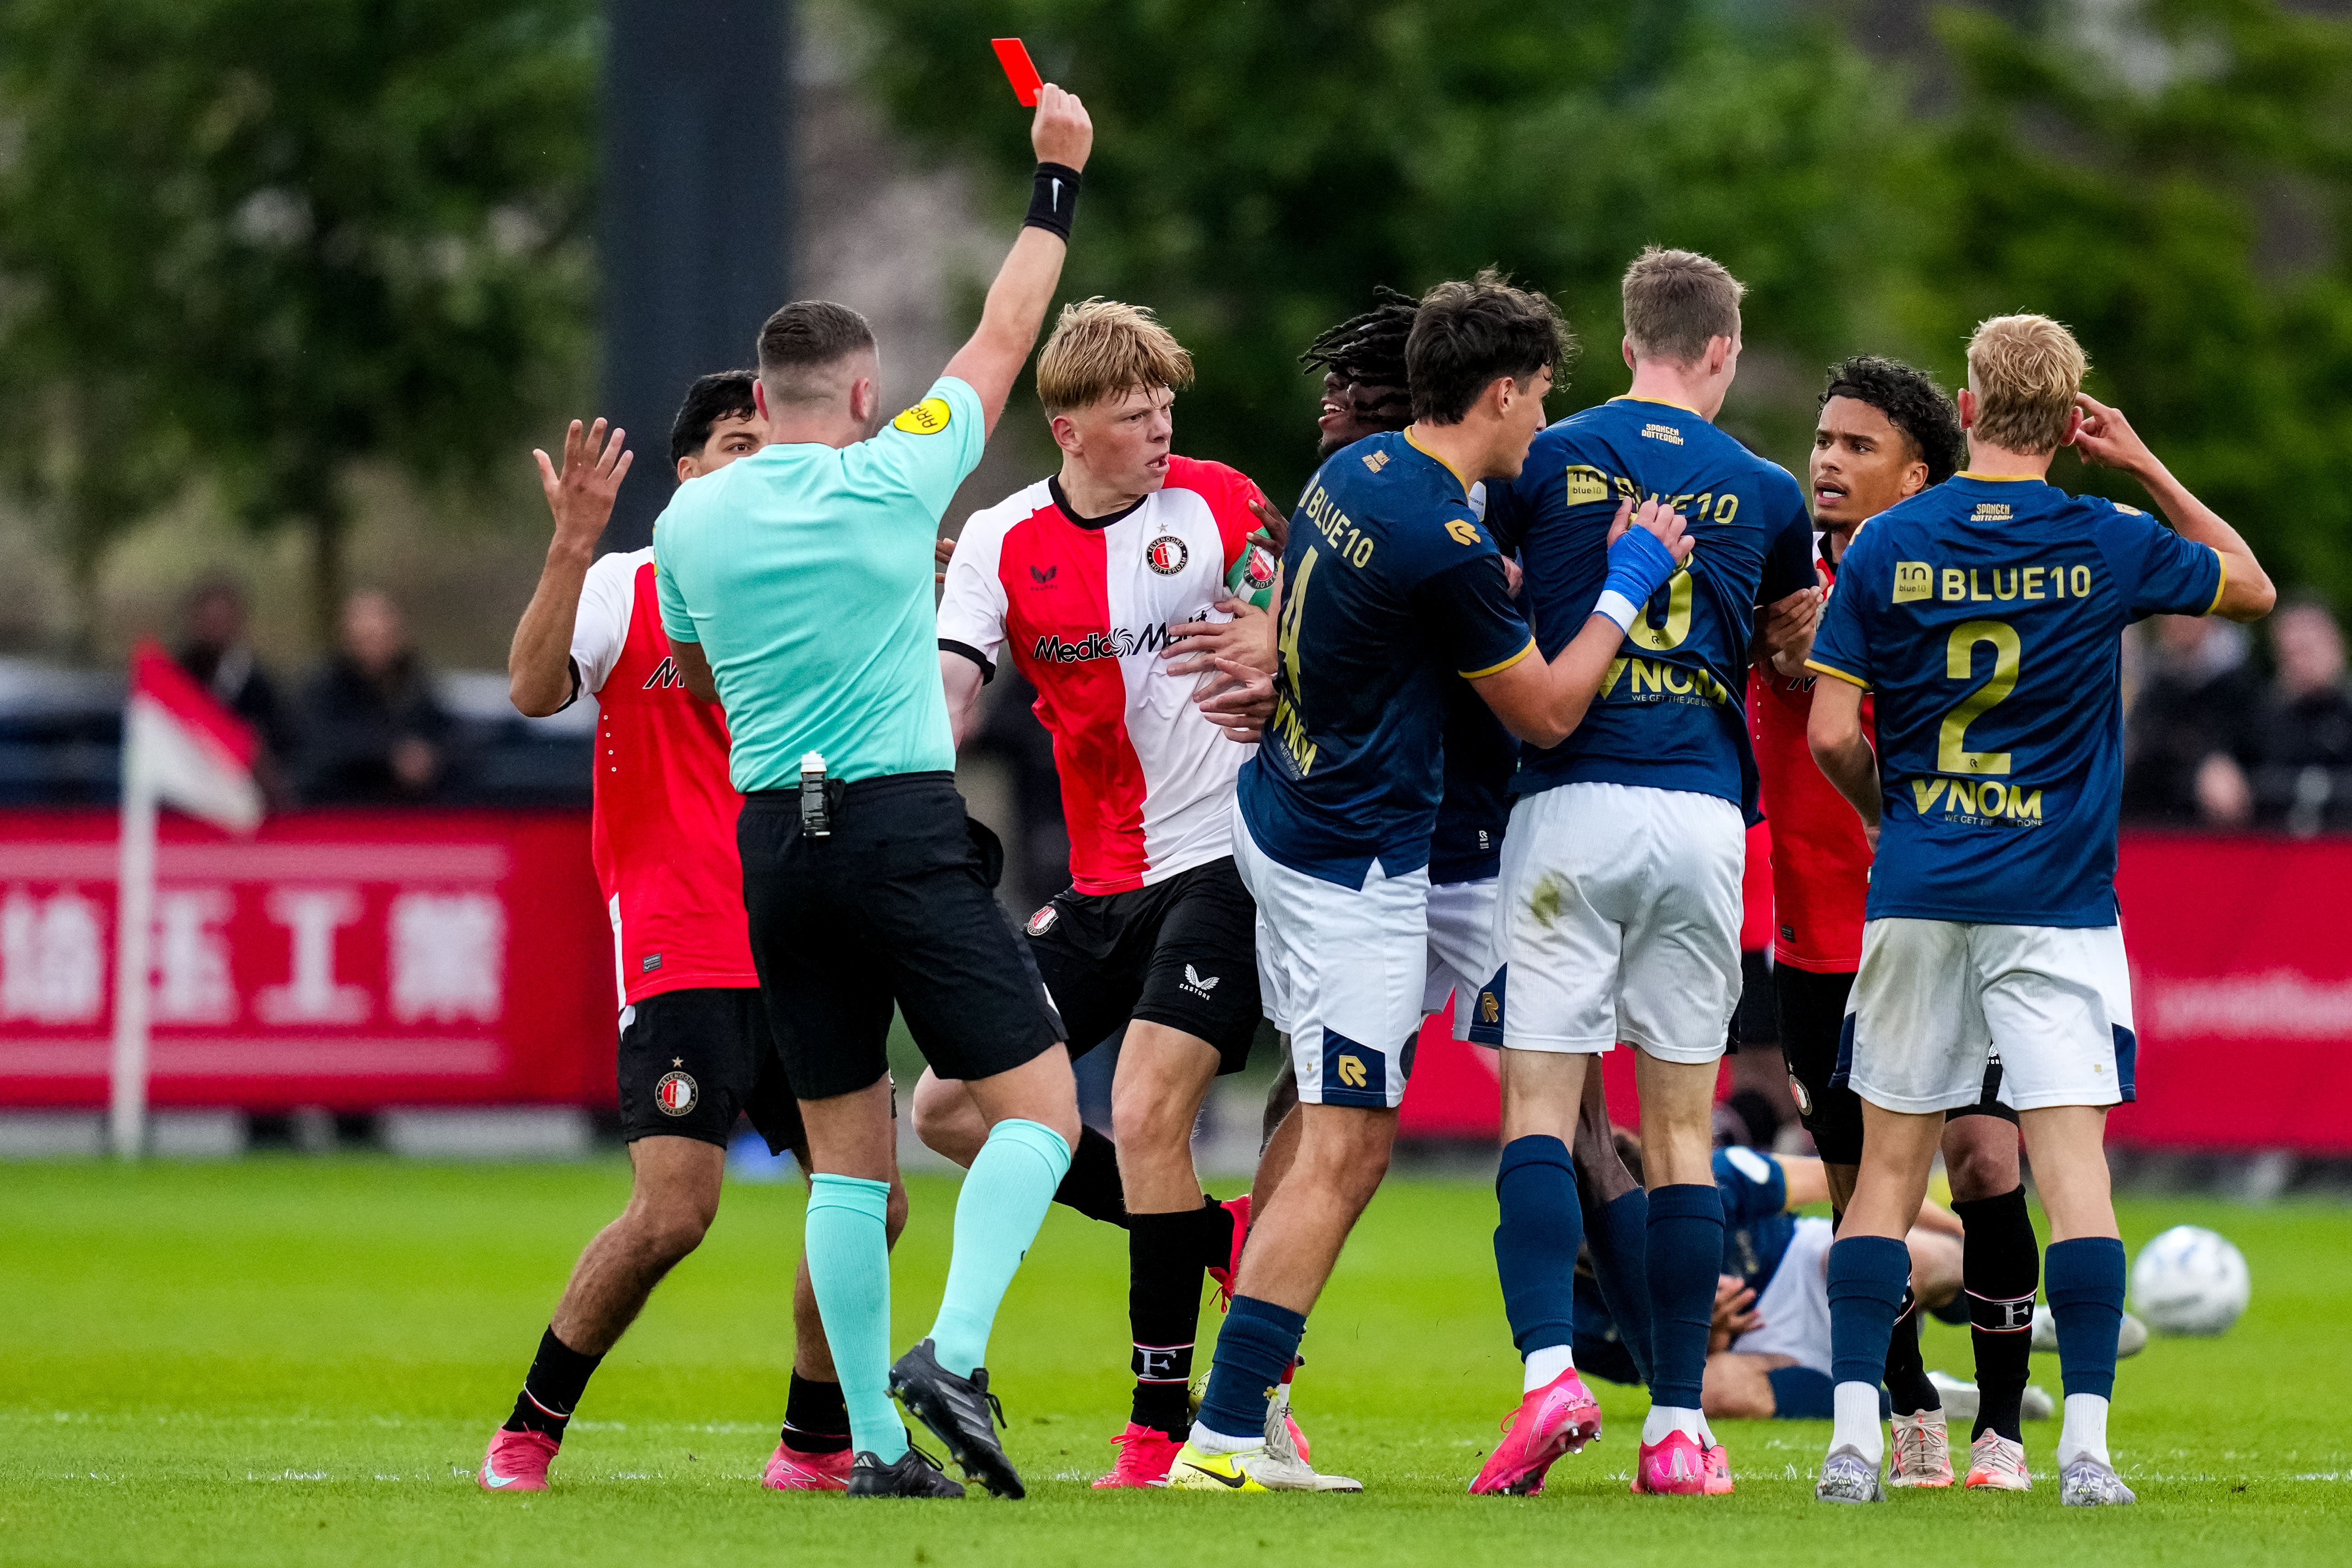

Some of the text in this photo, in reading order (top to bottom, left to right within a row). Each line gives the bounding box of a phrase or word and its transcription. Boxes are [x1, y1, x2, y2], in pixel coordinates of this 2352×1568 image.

[1641, 429, 1684, 446] ROTTERDAM
[1573, 486, 1601, 495] blue10
[1306, 485, 1374, 568] BLUE10
[1148, 537, 1184, 552] FEYENOORD
[1150, 557, 1187, 574] ROTTERDAM
[1942, 565, 2091, 601] BLUE10
[1668, 695, 1685, 704] THE
[1687, 697, 1700, 706] JOB
[1938, 620, 2021, 774] 2
[1944, 813, 1959, 823] WE
[1960, 815, 1978, 825] GET
[1179, 983, 1210, 1000] CASTORE
[1994, 1295, 2034, 1329] F
[1138, 1349, 1177, 1378] F
